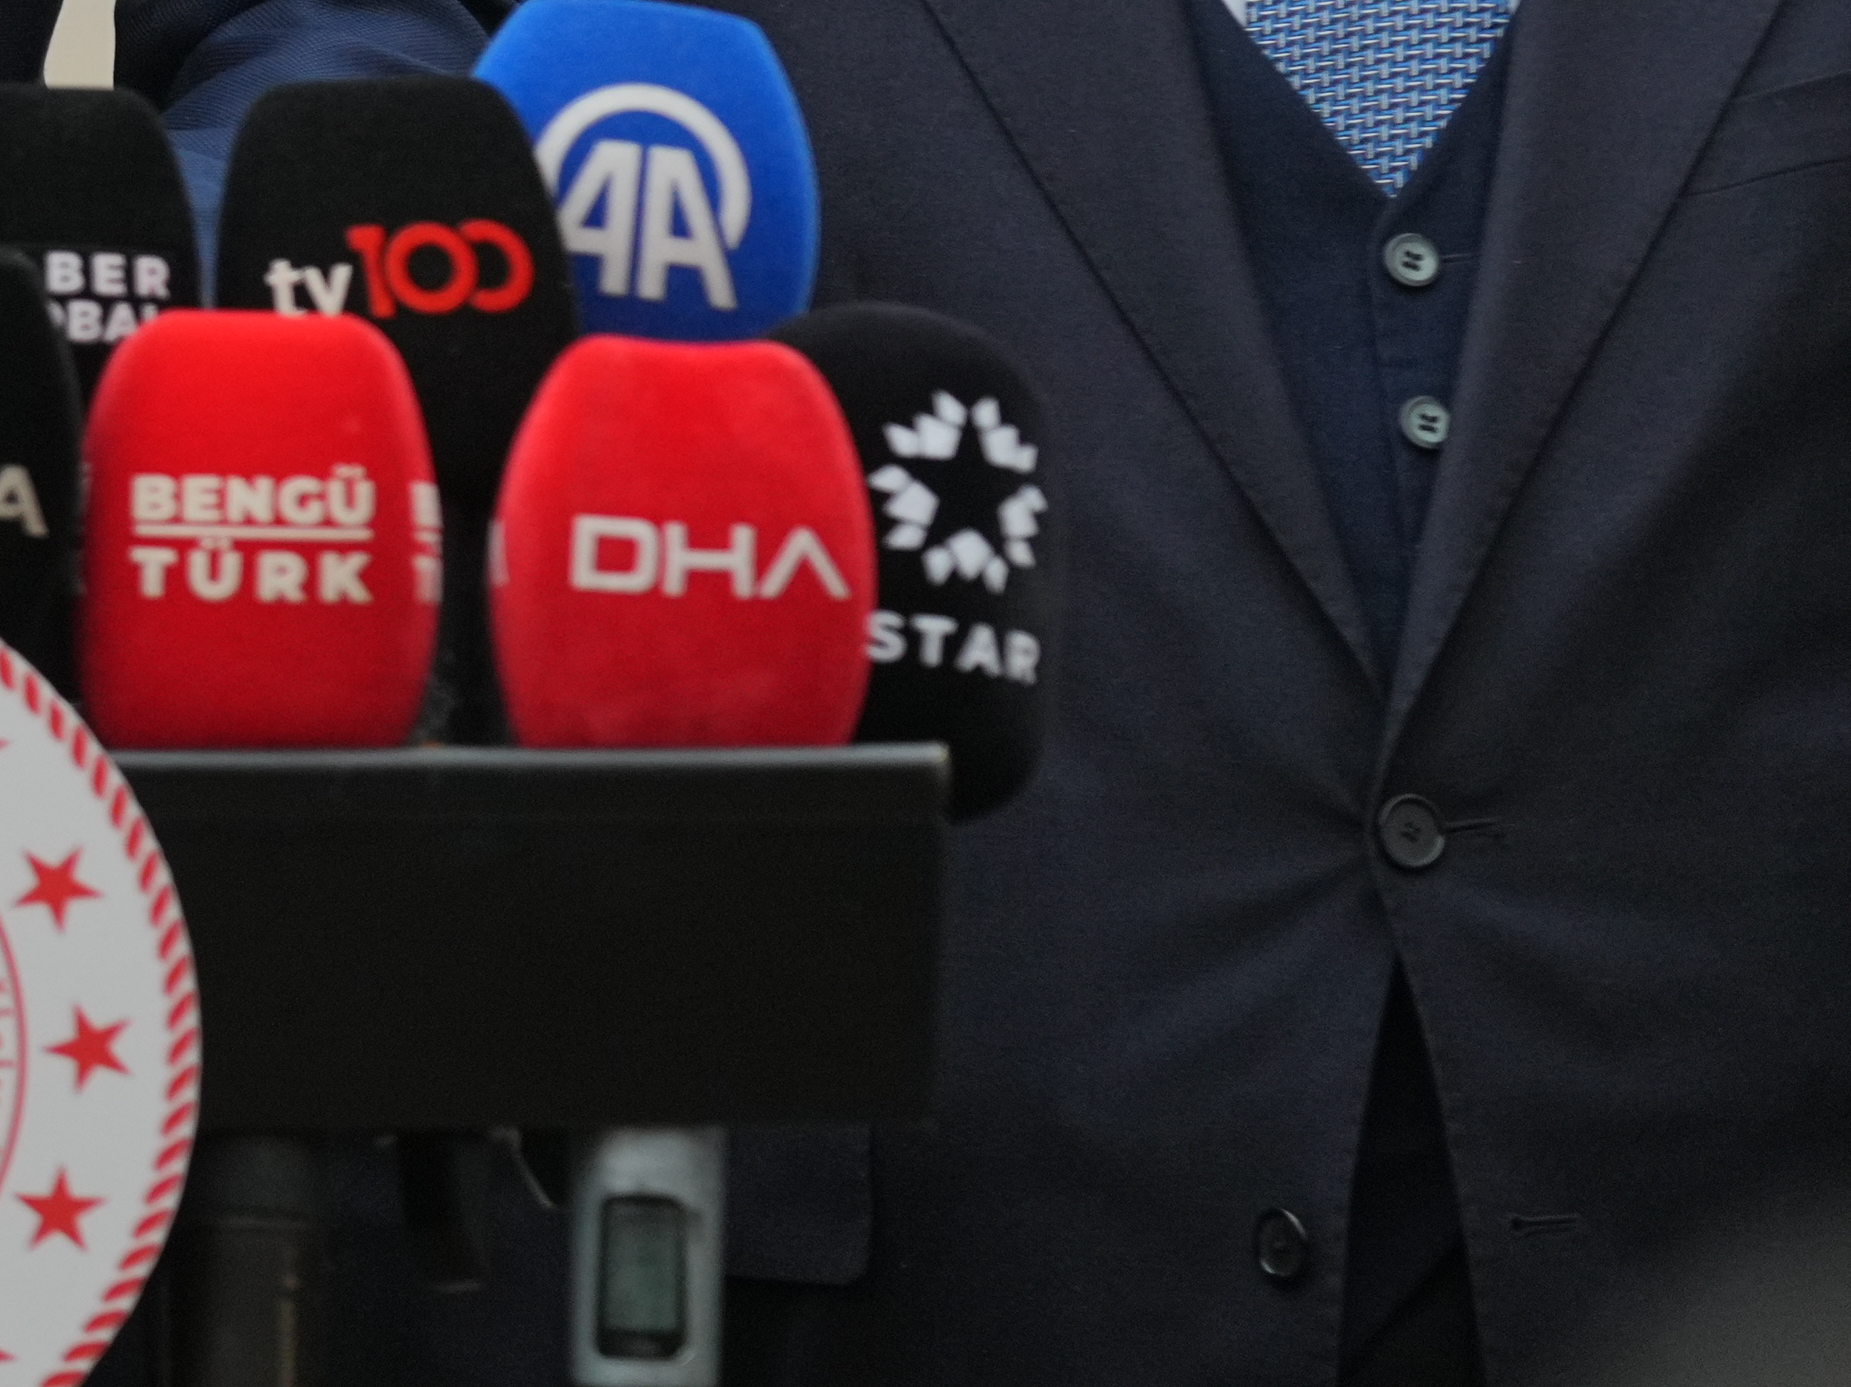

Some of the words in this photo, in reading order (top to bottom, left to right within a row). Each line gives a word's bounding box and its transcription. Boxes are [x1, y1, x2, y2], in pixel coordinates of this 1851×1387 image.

[44, 249, 171, 300] BER
[129, 463, 376, 526] BENGÜ
[128, 537, 374, 605] TÜRK
[567, 513, 852, 601] DHA
[864, 609, 1041, 686] STAR
